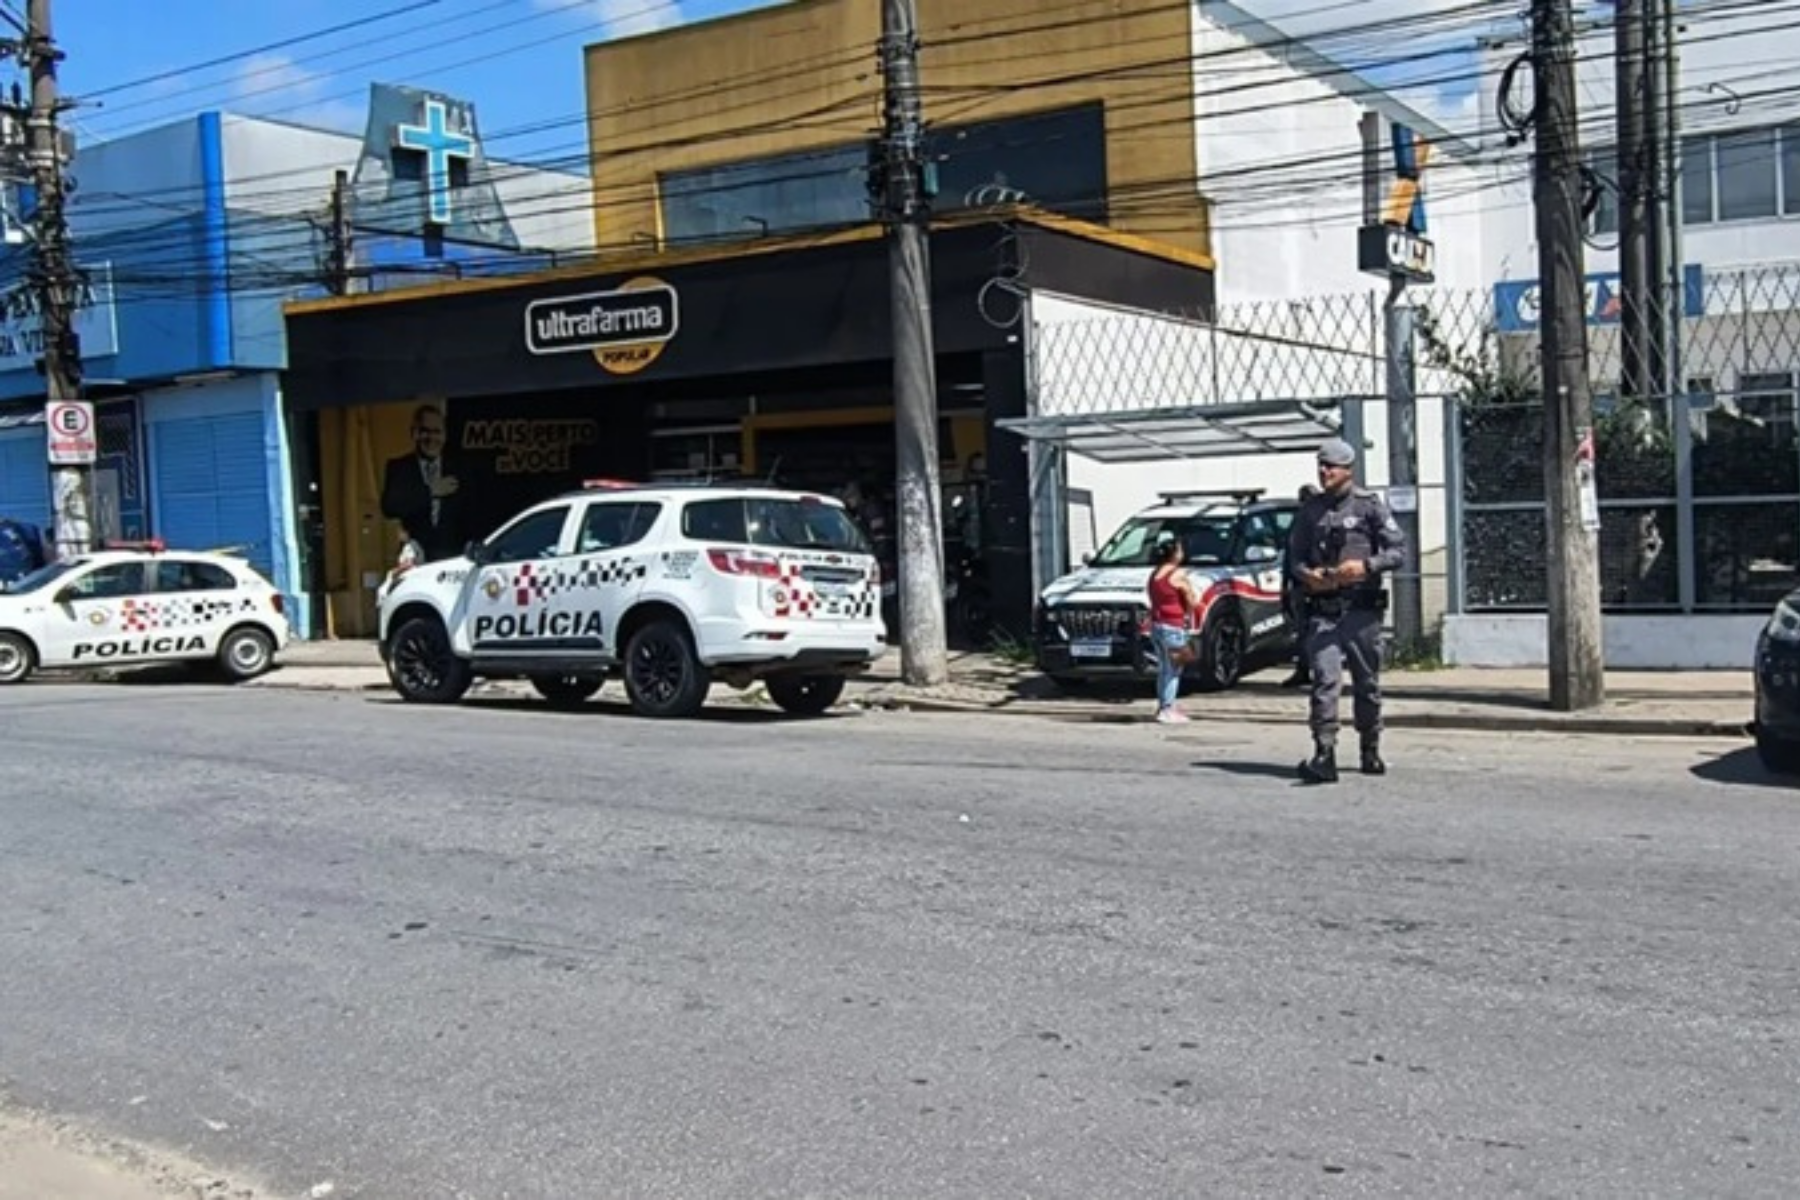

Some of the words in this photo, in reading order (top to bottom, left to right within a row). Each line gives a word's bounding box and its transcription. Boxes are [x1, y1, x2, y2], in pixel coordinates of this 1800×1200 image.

[537, 306, 662, 339] ultrafarma
[64, 410, 78, 430] E
[465, 422, 527, 446] MAIS
[474, 608, 603, 639] POLÍCIA
